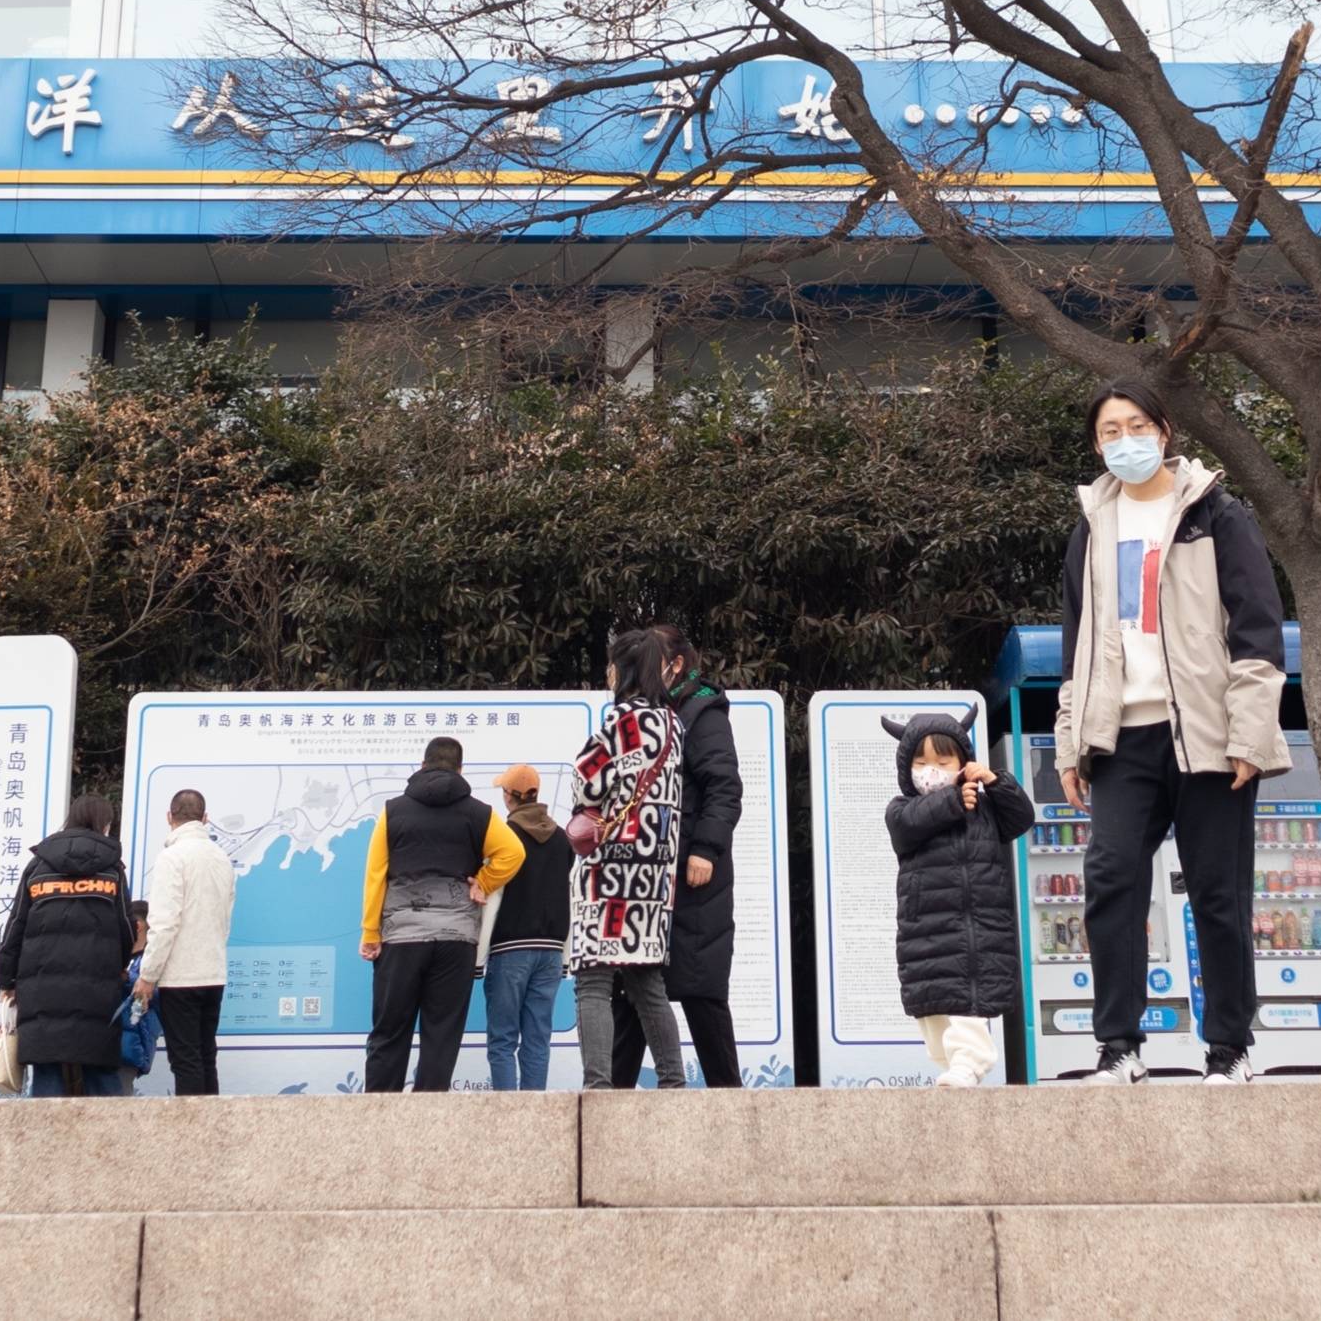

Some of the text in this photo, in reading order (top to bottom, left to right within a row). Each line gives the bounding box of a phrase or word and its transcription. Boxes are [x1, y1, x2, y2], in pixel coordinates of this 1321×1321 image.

[198, 712, 520, 728] 青岛奥帆海洋文化旅游区导游全景图
